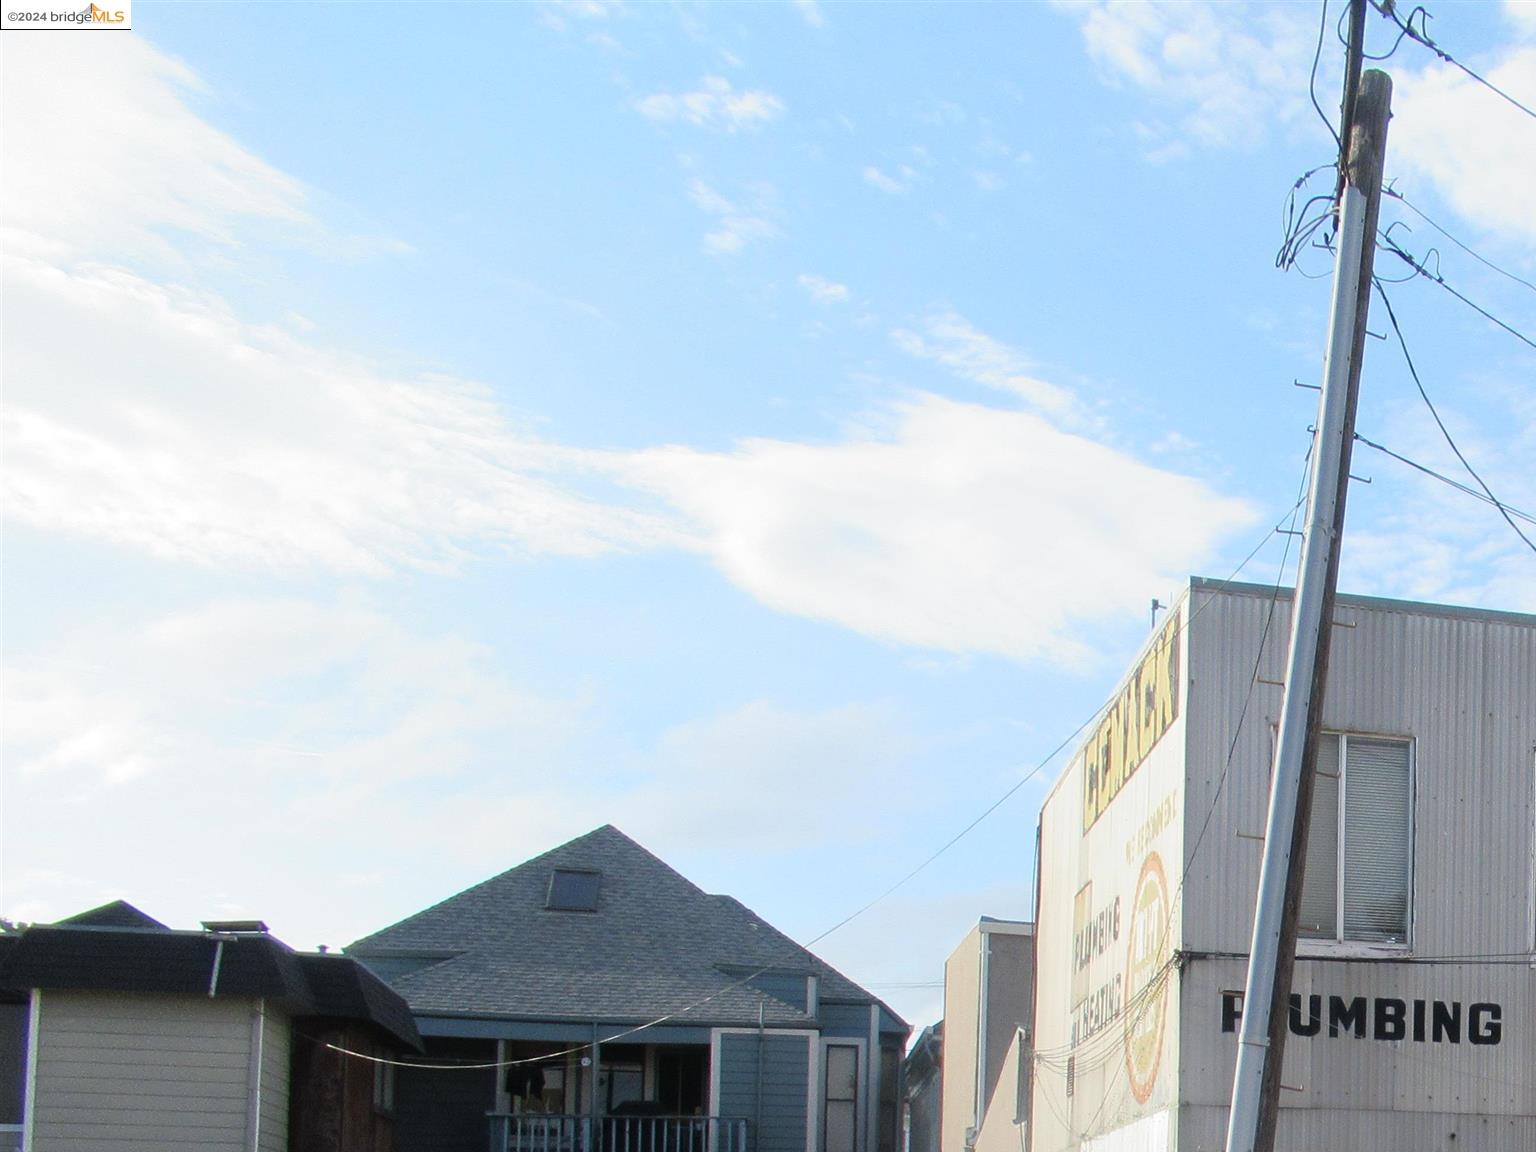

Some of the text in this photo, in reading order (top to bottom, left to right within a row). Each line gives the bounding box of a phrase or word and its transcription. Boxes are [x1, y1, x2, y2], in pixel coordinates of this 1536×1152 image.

[1073, 895, 1121, 975] PLUMBING
[1083, 972, 1121, 1041] HEATING
[1221, 989, 1502, 1045] PUMBING
